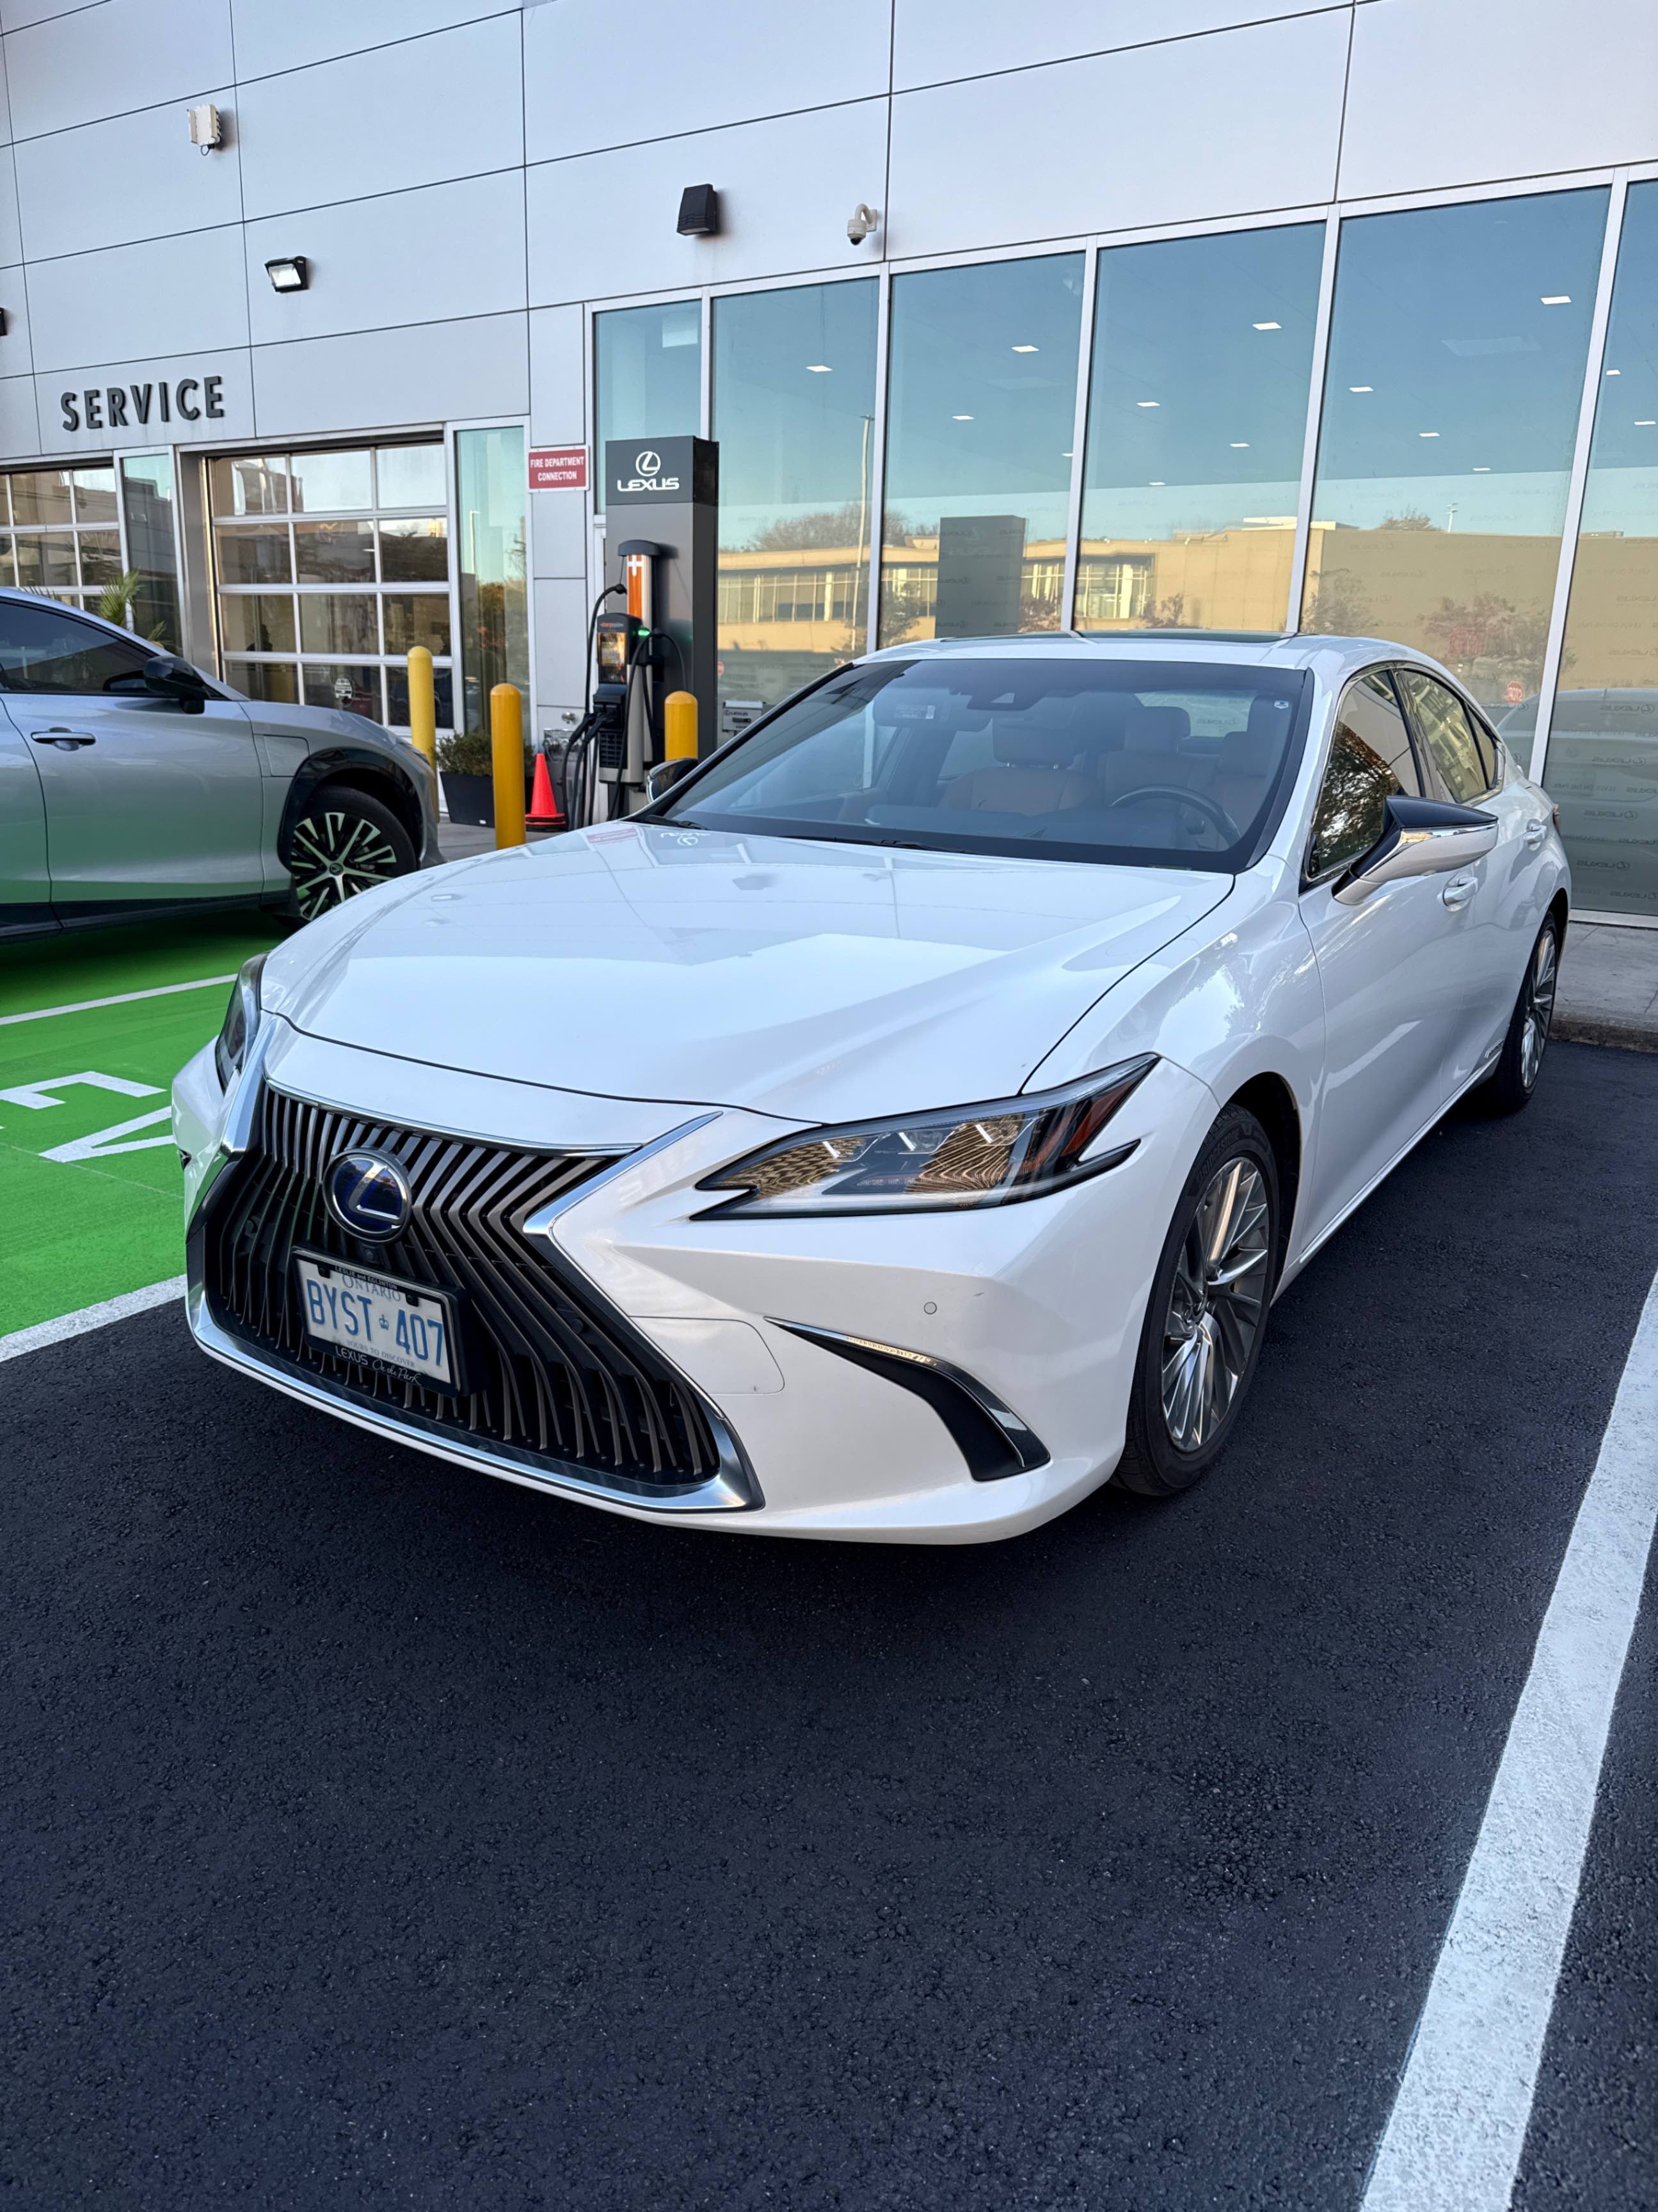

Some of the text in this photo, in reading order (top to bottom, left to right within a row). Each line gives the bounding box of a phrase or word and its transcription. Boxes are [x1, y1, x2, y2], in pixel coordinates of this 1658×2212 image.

[61, 376, 225, 431] SERVICE
[530, 456, 584, 468] FIRE DEPARTMENT
[538, 471, 577, 481] CONNECTION
[617, 477, 680, 492] LEXUS
[335, 1265, 356, 1278] LESLIE
[367, 1275, 398, 1290] EGLINTON
[342, 1274, 401, 1302] ONTARIO
[307, 1279, 443, 1366] BYST 407
[335, 1345, 422, 1384] LEXUS On the Park
[347, 1339, 416, 1368] YOURS TO DISCOVER
